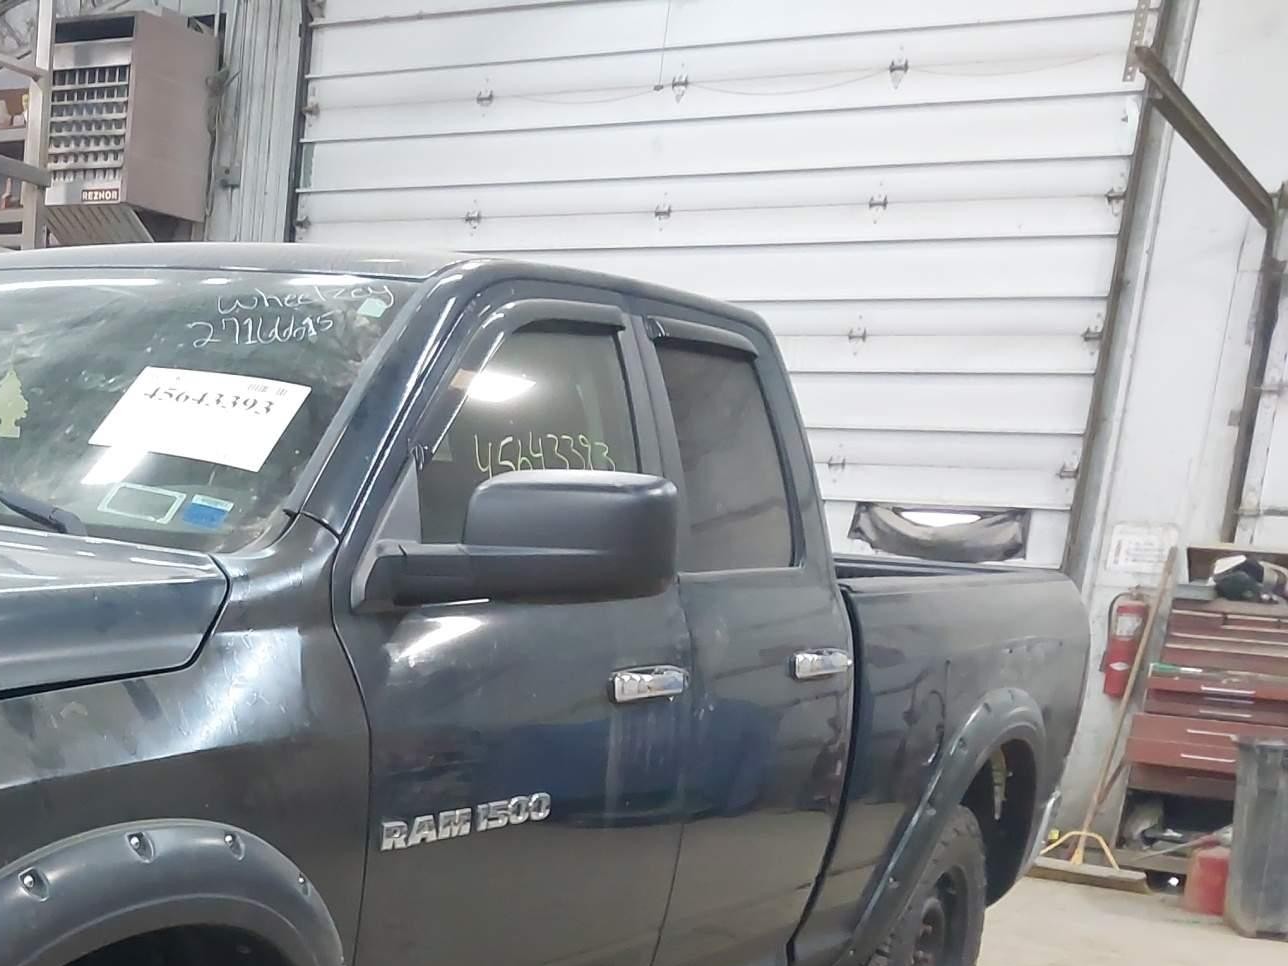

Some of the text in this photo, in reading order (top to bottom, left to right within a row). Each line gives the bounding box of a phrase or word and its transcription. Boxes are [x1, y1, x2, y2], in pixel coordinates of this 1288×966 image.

[474, 431, 616, 480] 45643393
[380, 791, 552, 852] RAM 1500
